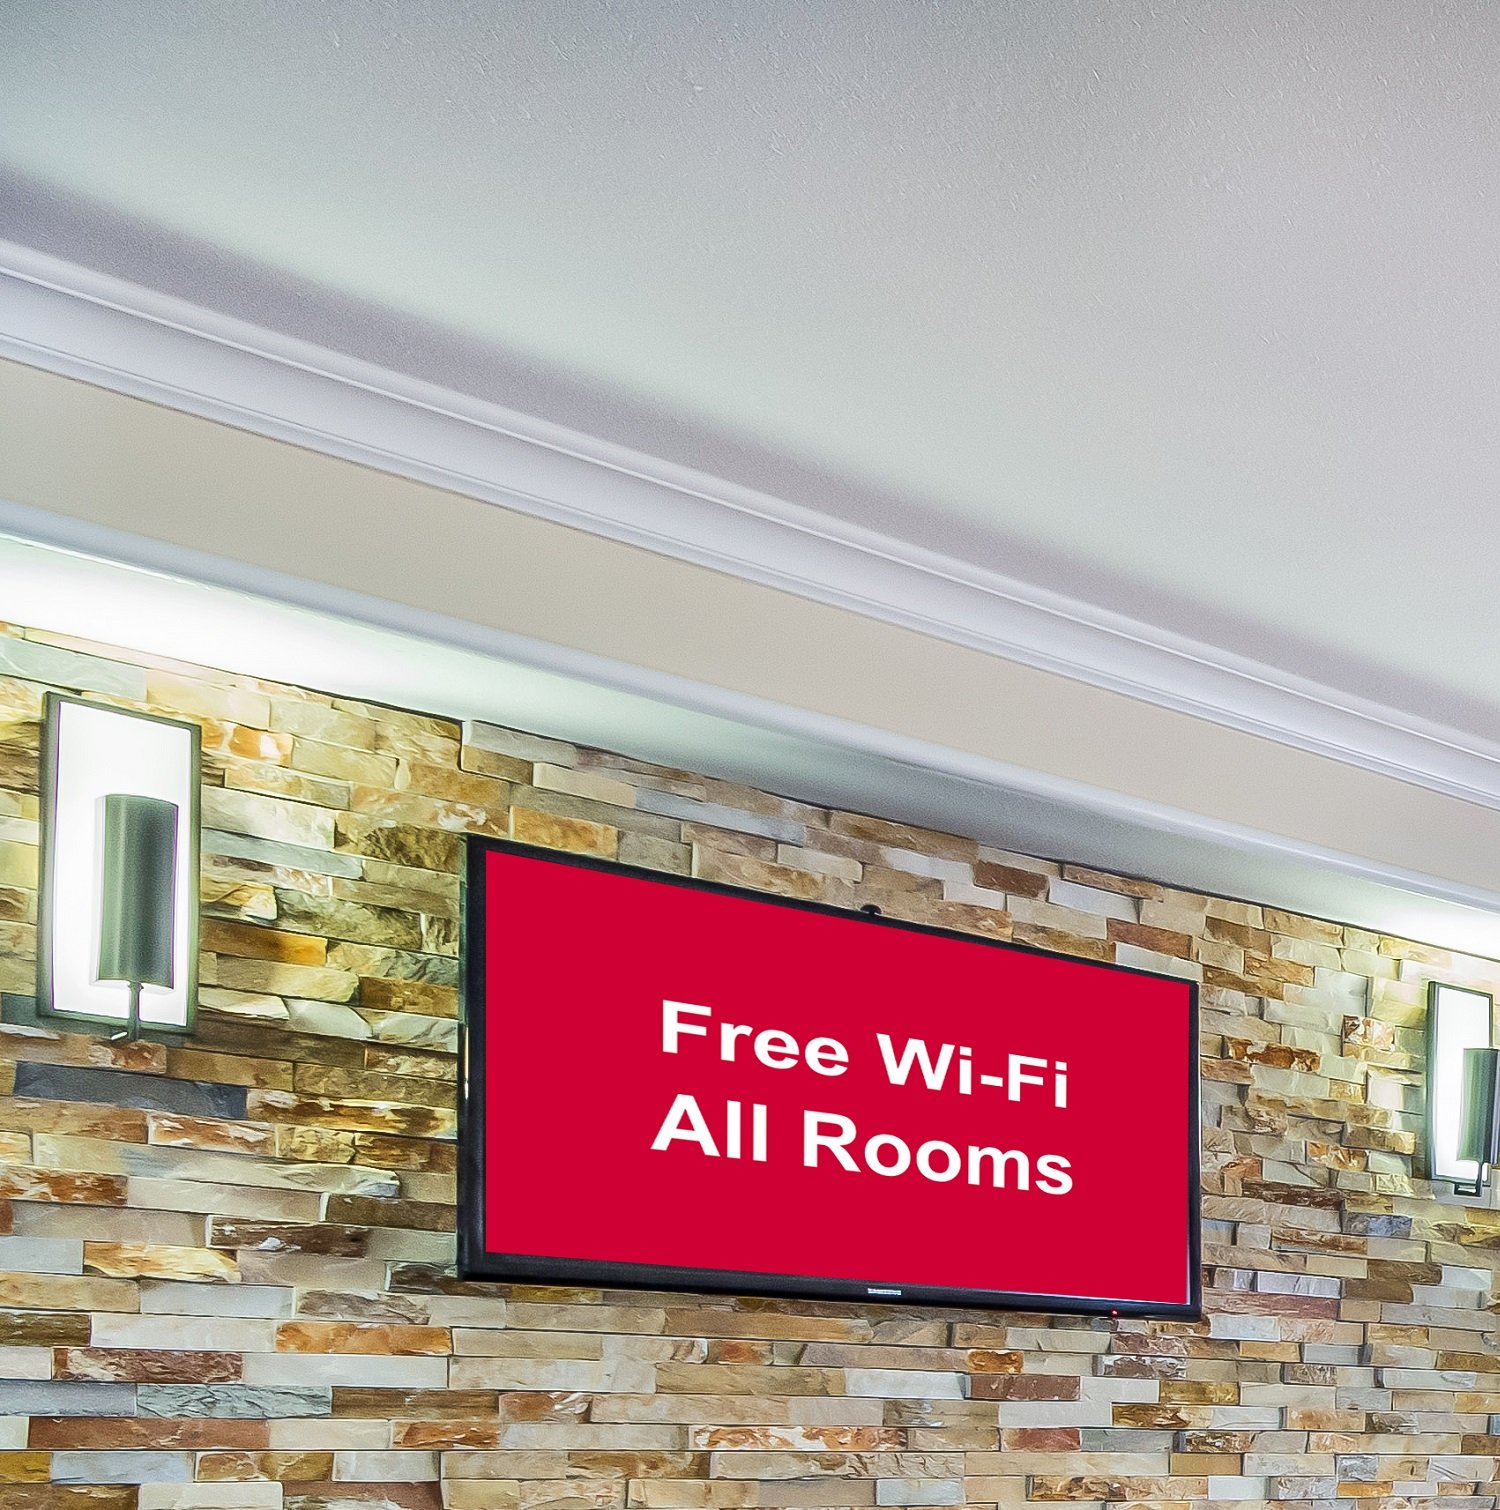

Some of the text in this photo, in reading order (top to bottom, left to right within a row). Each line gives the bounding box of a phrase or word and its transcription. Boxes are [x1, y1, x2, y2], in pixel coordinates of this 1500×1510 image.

[663, 1000, 1067, 1108] Free Wi-Fi
[651, 1094, 1072, 1195] All Rooms
